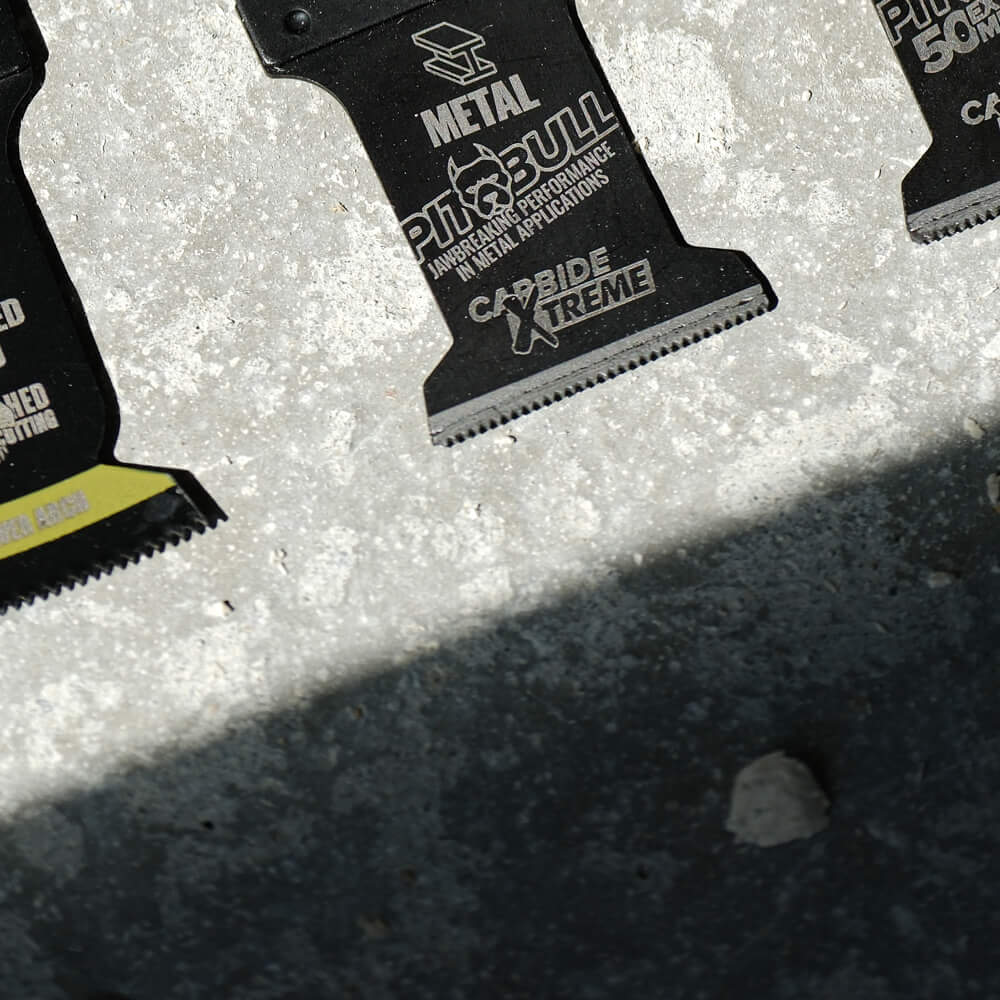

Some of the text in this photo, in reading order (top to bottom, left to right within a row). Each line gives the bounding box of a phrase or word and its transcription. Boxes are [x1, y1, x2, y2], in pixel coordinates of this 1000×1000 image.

[911, 9, 981, 74] 50
[419, 73, 541, 149] METAL
[427, 140, 616, 280] JAWBREAKING PERFORMANCE
[455, 168, 610, 283] IN METAL APPLICATIONS
